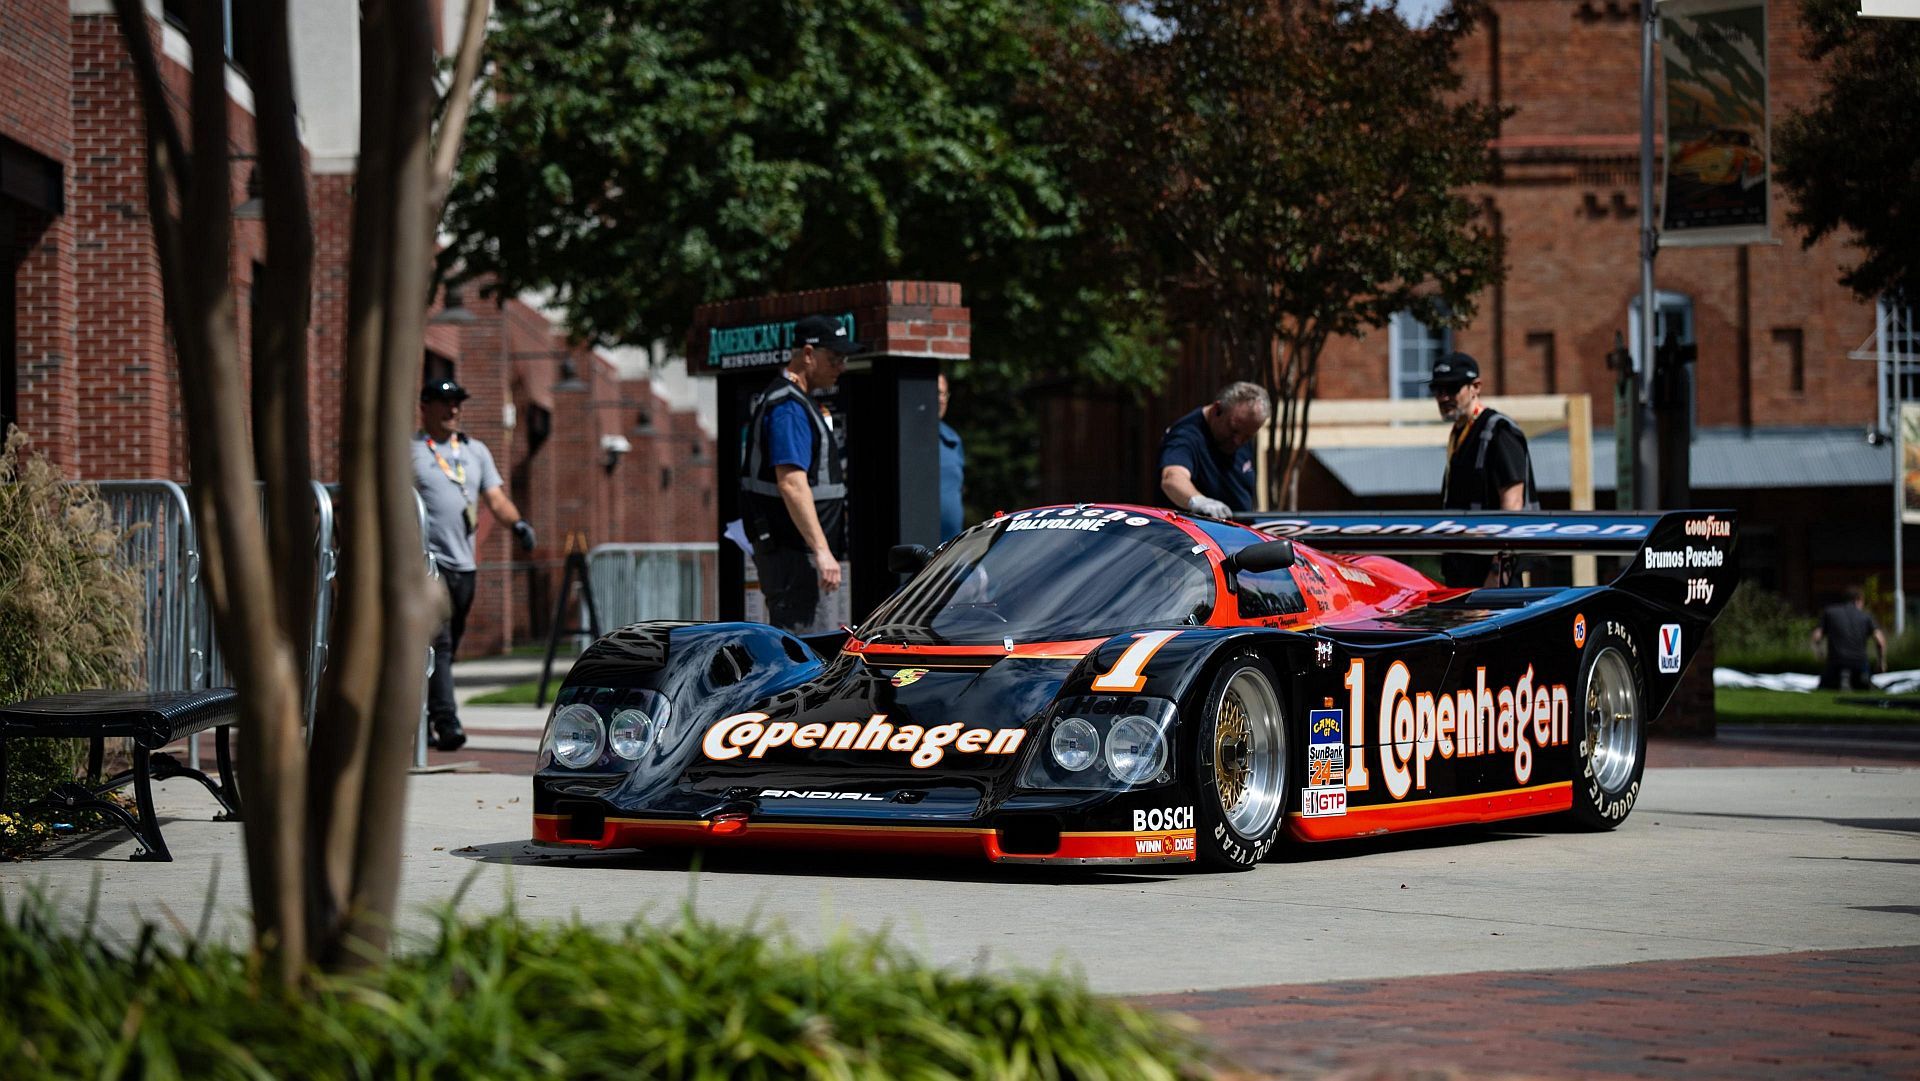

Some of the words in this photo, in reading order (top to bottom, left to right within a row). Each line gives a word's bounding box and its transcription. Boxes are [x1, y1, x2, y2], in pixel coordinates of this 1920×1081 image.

[708, 323, 780, 366] AMERICAN
[721, 352, 779, 369] HISTORIC
[986, 508, 1151, 528] Porsche
[1006, 518, 1107, 532] VALVOLINE
[1685, 515, 1730, 540] GOODYEAR
[1645, 547, 1684, 569] Brumos
[1686, 546, 1723, 567] Porsche
[1684, 578, 1714, 605] jiffy
[1090, 630, 1185, 693] 1
[1313, 718, 1341, 733] CAMEL
[1323, 727, 1331, 737] GT
[1344, 658, 1369, 791] 1
[1379, 660, 1569, 800] Copenhagen
[702, 711, 1027, 769] Copenhagen
[1309, 745, 1343, 760] SunBank
[1311, 759, 1331, 785] 24
[759, 789, 884, 801] ANDIAL
[1319, 793, 1345, 811] GTP
[1133, 805, 1194, 831] BOSCH
[1136, 840, 1162, 853] WINN
[1175, 837, 1195, 851] DIXIE
